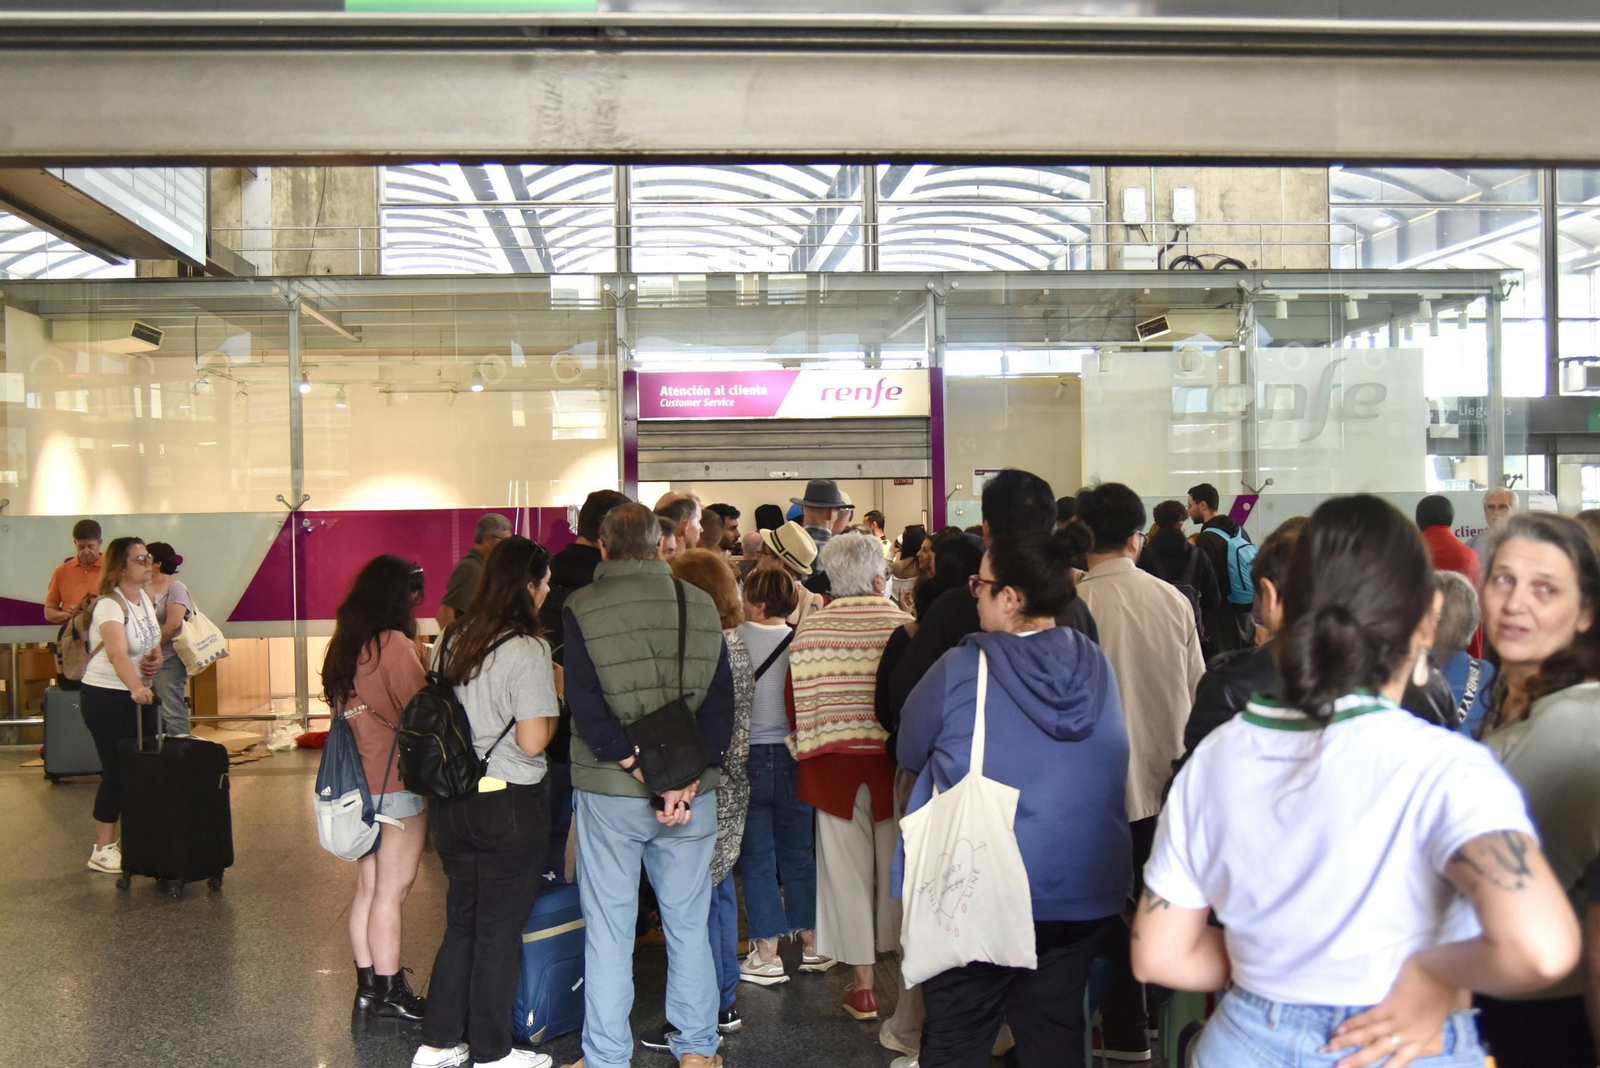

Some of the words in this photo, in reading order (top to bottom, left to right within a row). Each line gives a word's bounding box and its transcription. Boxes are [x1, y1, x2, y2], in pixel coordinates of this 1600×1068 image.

[660, 384, 710, 396] Atención
[714, 384, 725, 396] al
[728, 384, 768, 396] cliente
[820, 377, 903, 409] renfe
[660, 398, 701, 407] Customer
[703, 397, 735, 407] Service
[1458, 404, 1512, 419] Llegas
[1454, 525, 1488, 538] clien
